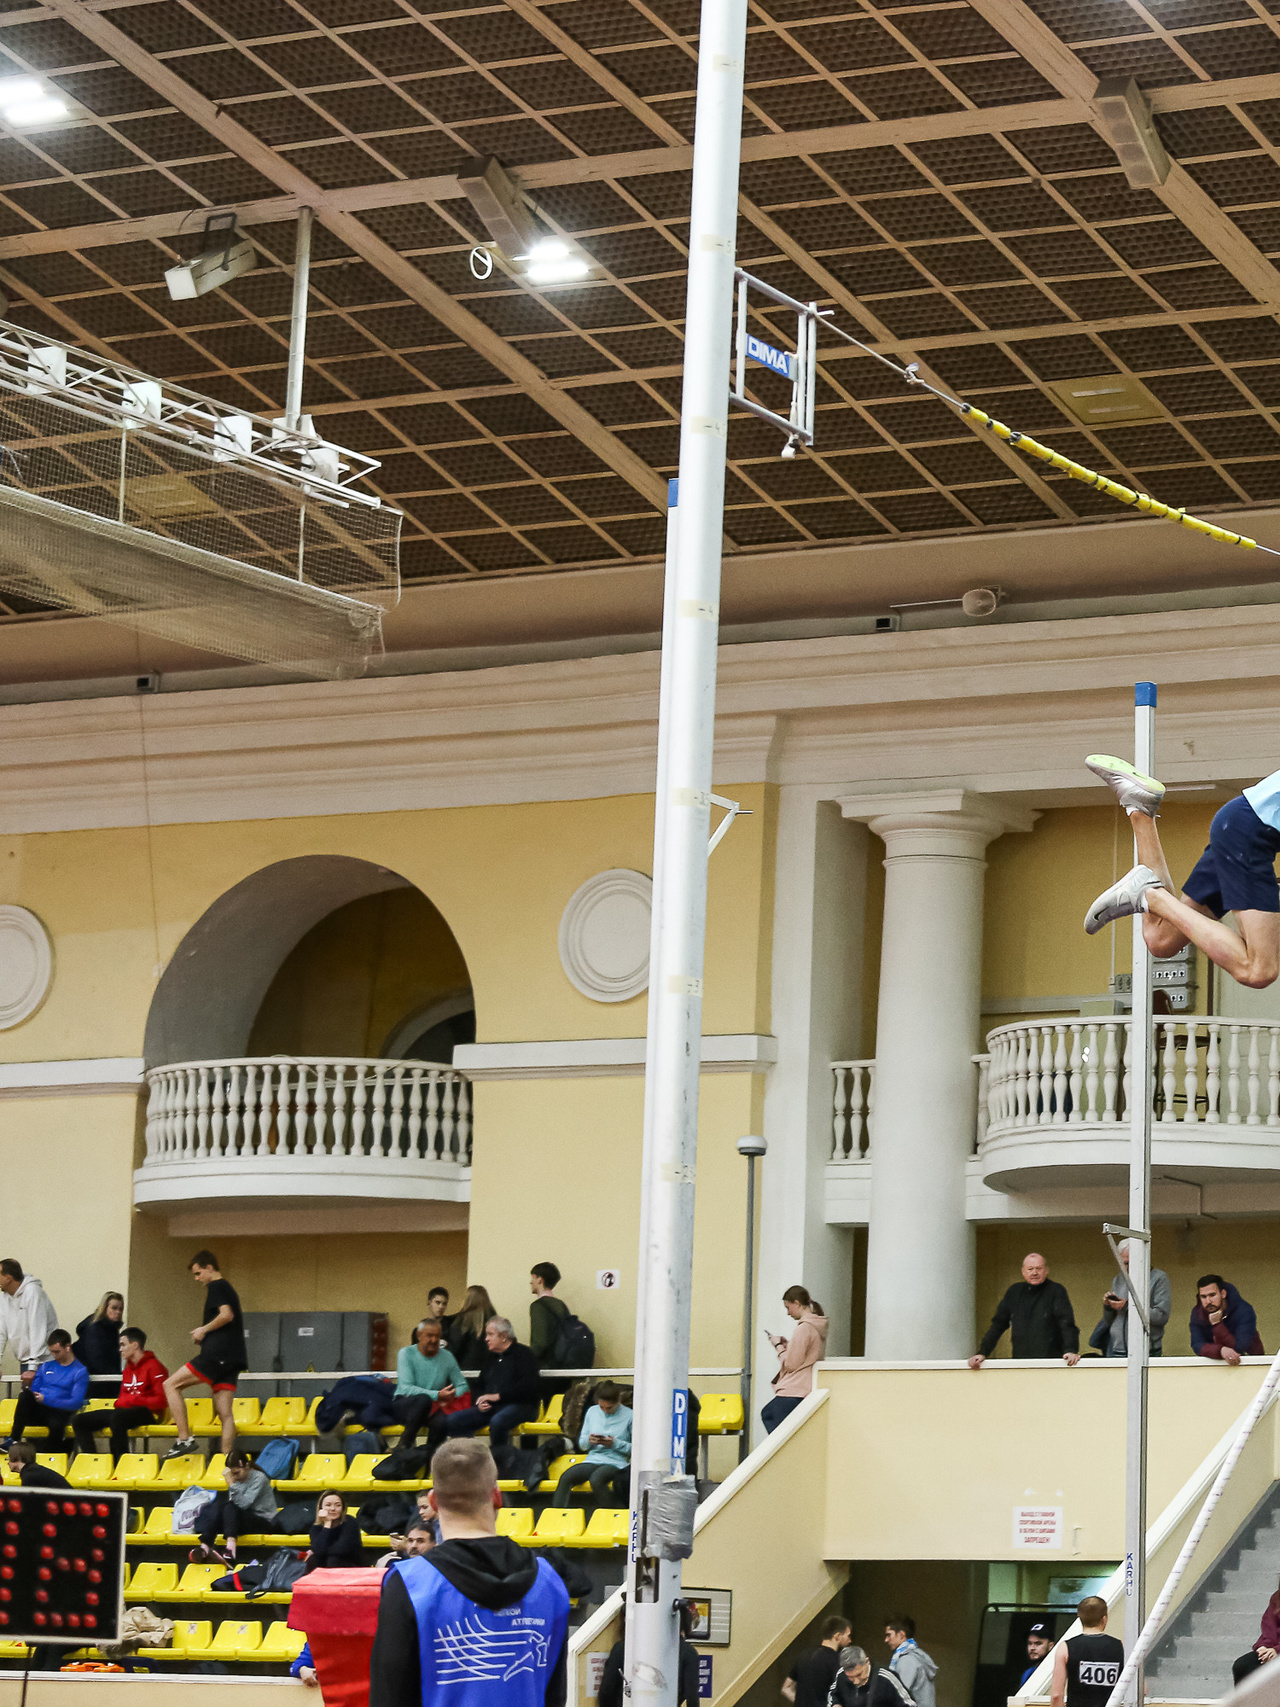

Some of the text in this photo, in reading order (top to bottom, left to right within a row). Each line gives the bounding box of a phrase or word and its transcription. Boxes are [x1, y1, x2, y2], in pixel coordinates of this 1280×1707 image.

[748, 336, 788, 375] DIMA
[673, 1392, 687, 1477] DIMA
[1126, 1552, 1134, 1597] KARHU
[1081, 1666, 1117, 1685] 406
